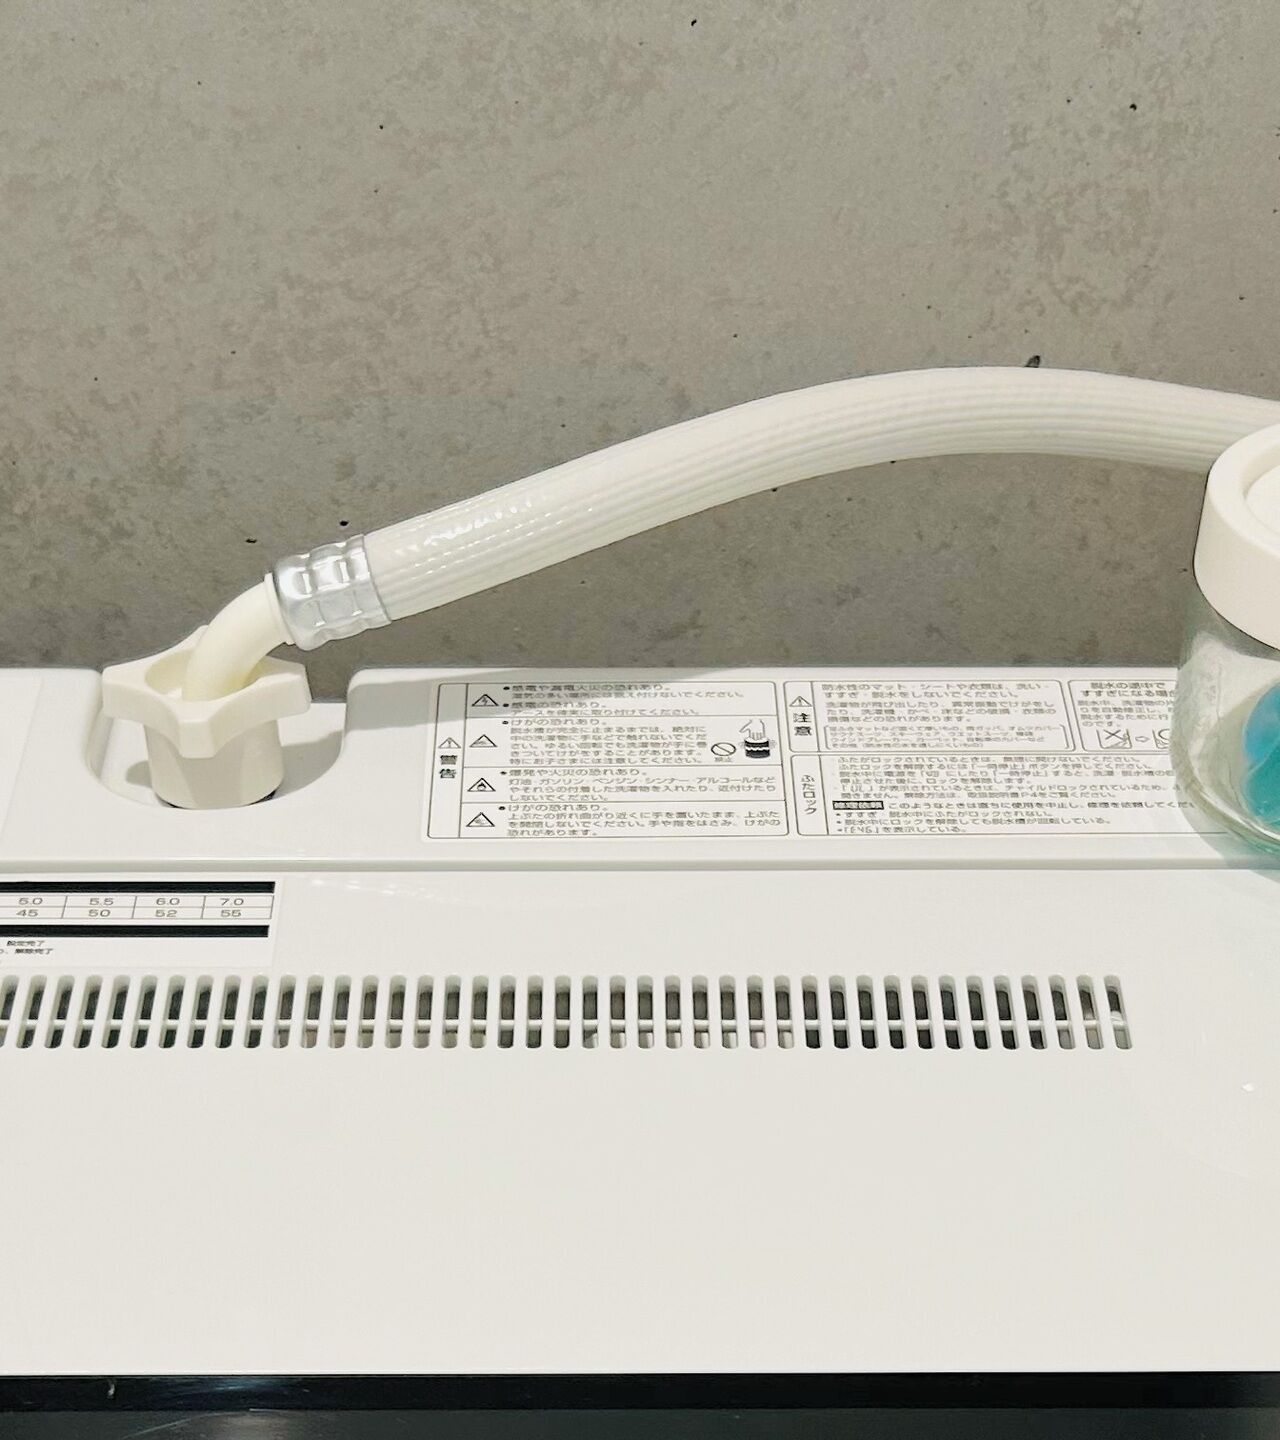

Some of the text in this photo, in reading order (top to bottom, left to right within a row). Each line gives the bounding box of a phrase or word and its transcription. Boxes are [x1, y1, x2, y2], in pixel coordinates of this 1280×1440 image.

[18, 898, 44, 906] 5.0
[89, 898, 114, 906] 5.5
[155, 898, 181, 906] 6.0
[220, 898, 245, 906] 7.0
[16, 909, 39, 917] 45
[88, 909, 111, 917] 50
[155, 909, 178, 917] 52
[220, 909, 242, 917] 55
